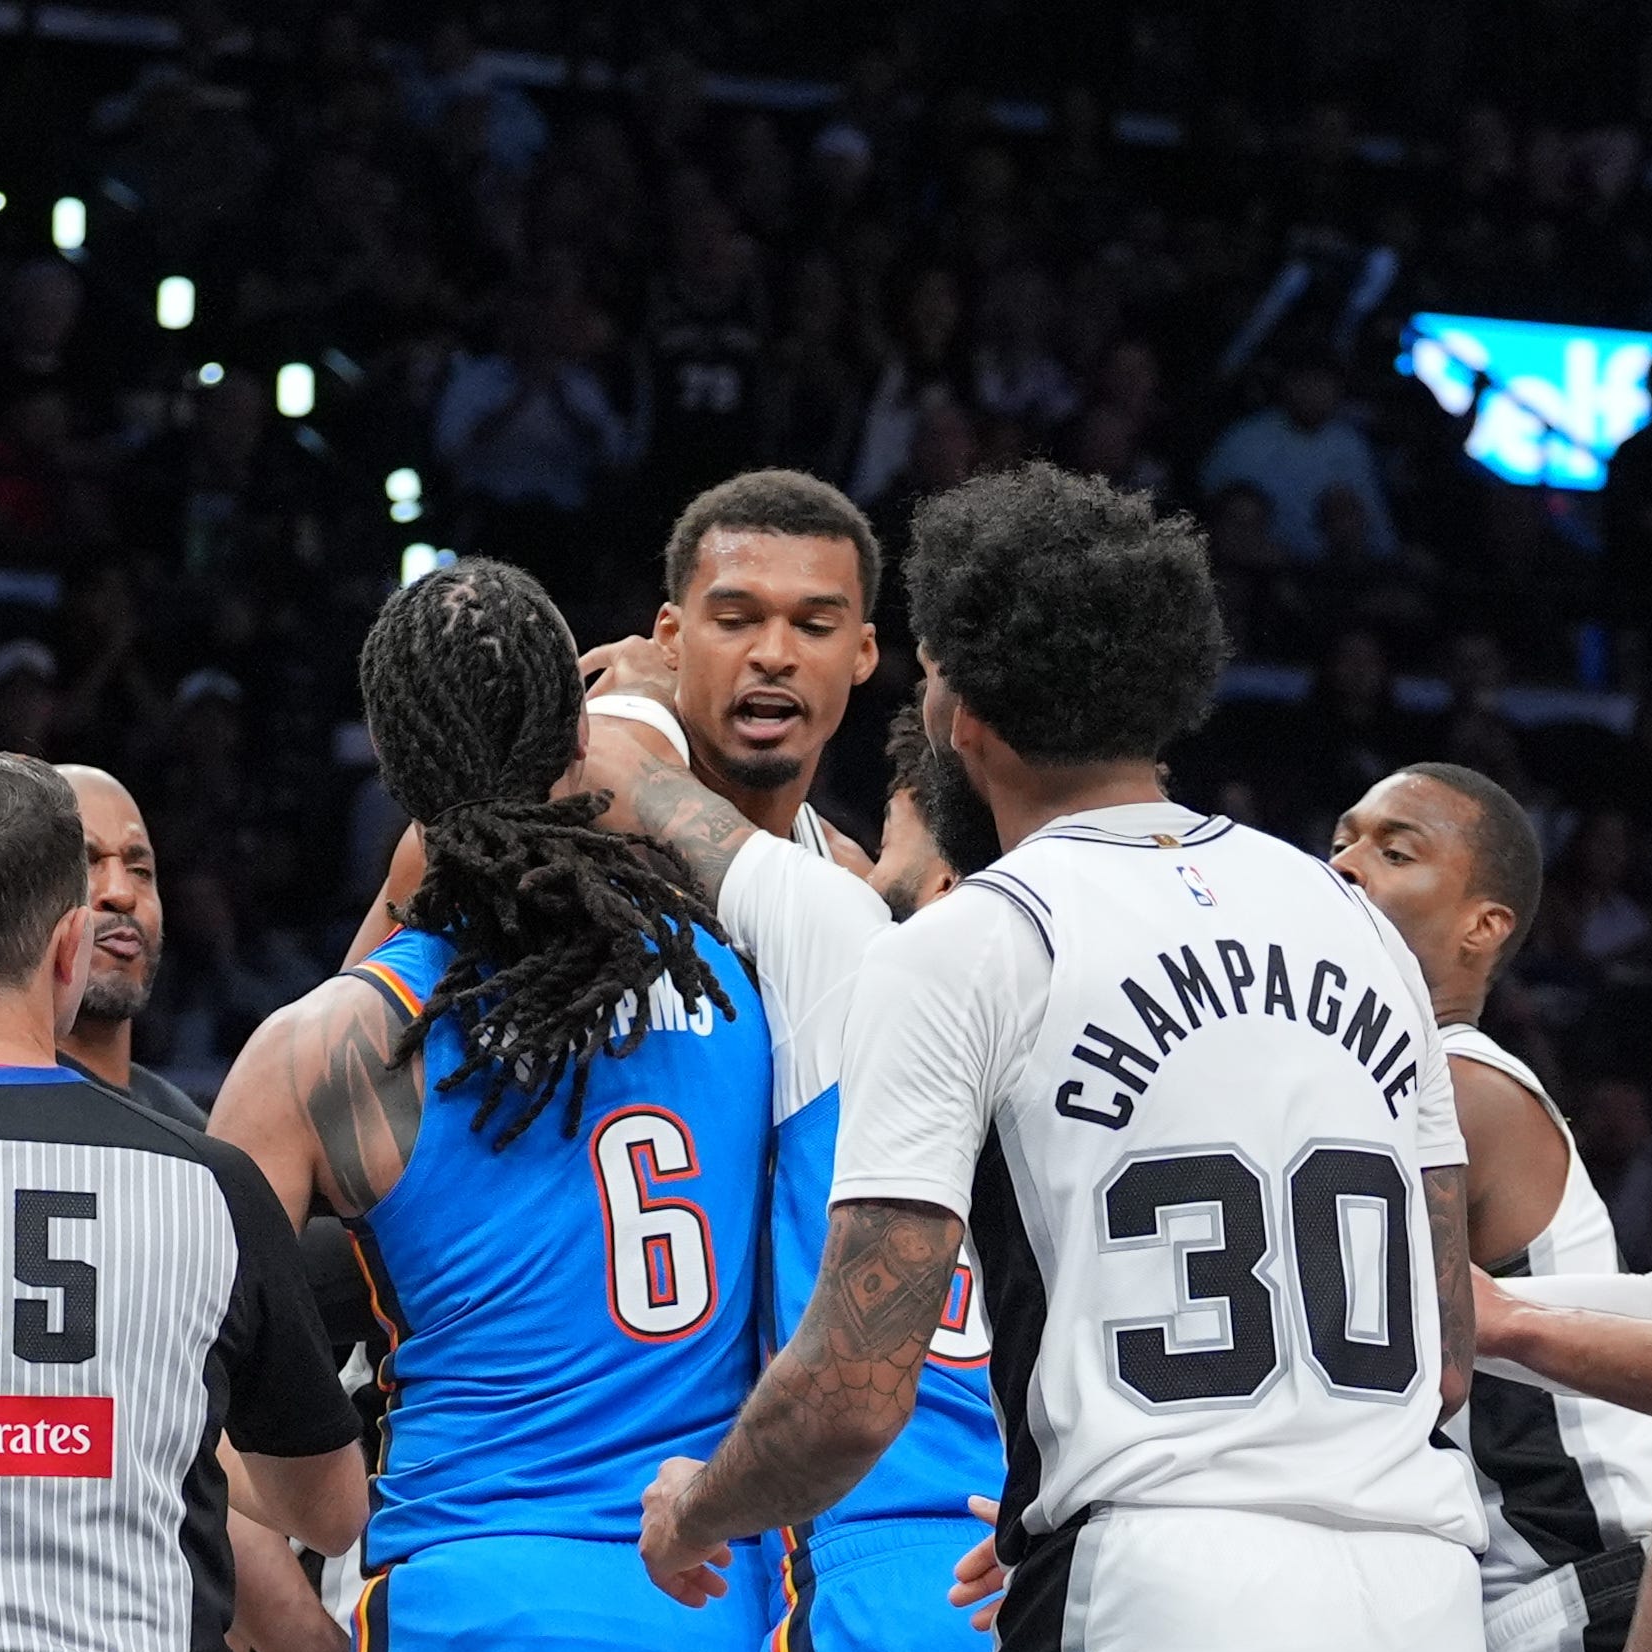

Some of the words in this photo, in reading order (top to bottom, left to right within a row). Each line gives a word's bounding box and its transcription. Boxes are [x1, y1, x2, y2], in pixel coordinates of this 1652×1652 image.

[1055, 938, 1418, 1131] CHAMPAGNIE
[588, 1104, 720, 1346] 6
[1095, 1137, 1425, 1417] 30
